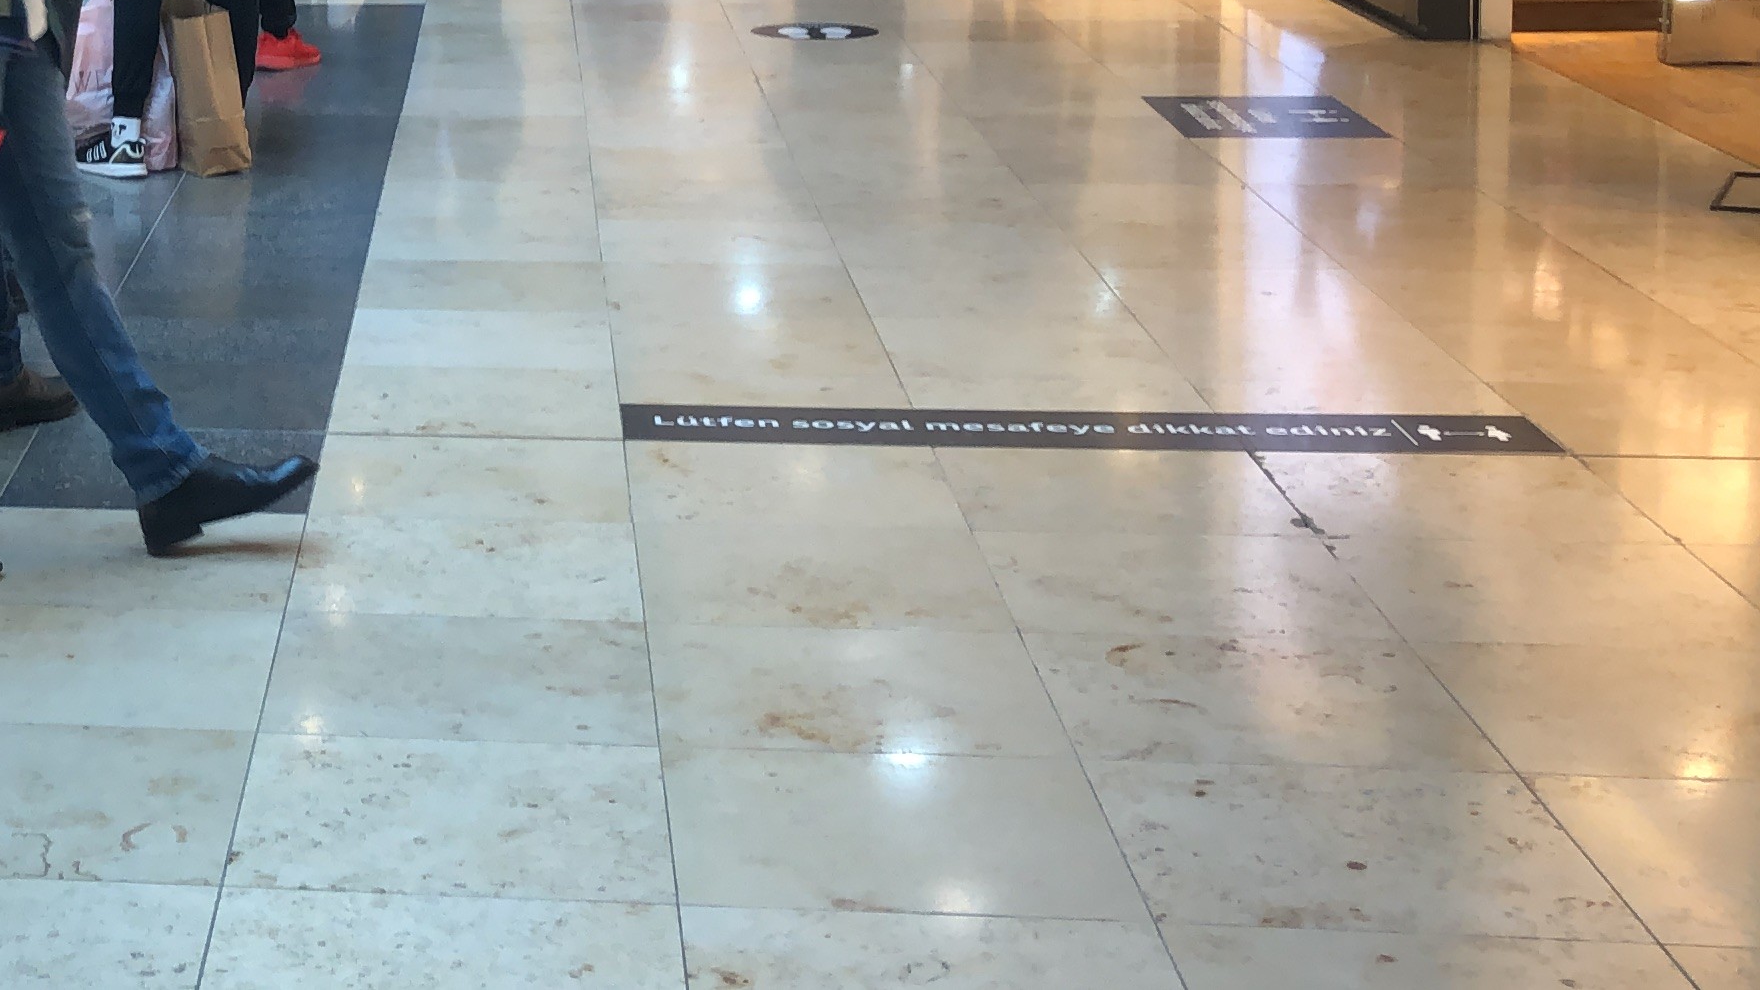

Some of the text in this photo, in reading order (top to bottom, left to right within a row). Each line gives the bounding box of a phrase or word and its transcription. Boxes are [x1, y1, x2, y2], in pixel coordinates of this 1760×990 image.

[653, 414, 1392, 437] Lütfen sosyal mesafeye dikkat ediniz
